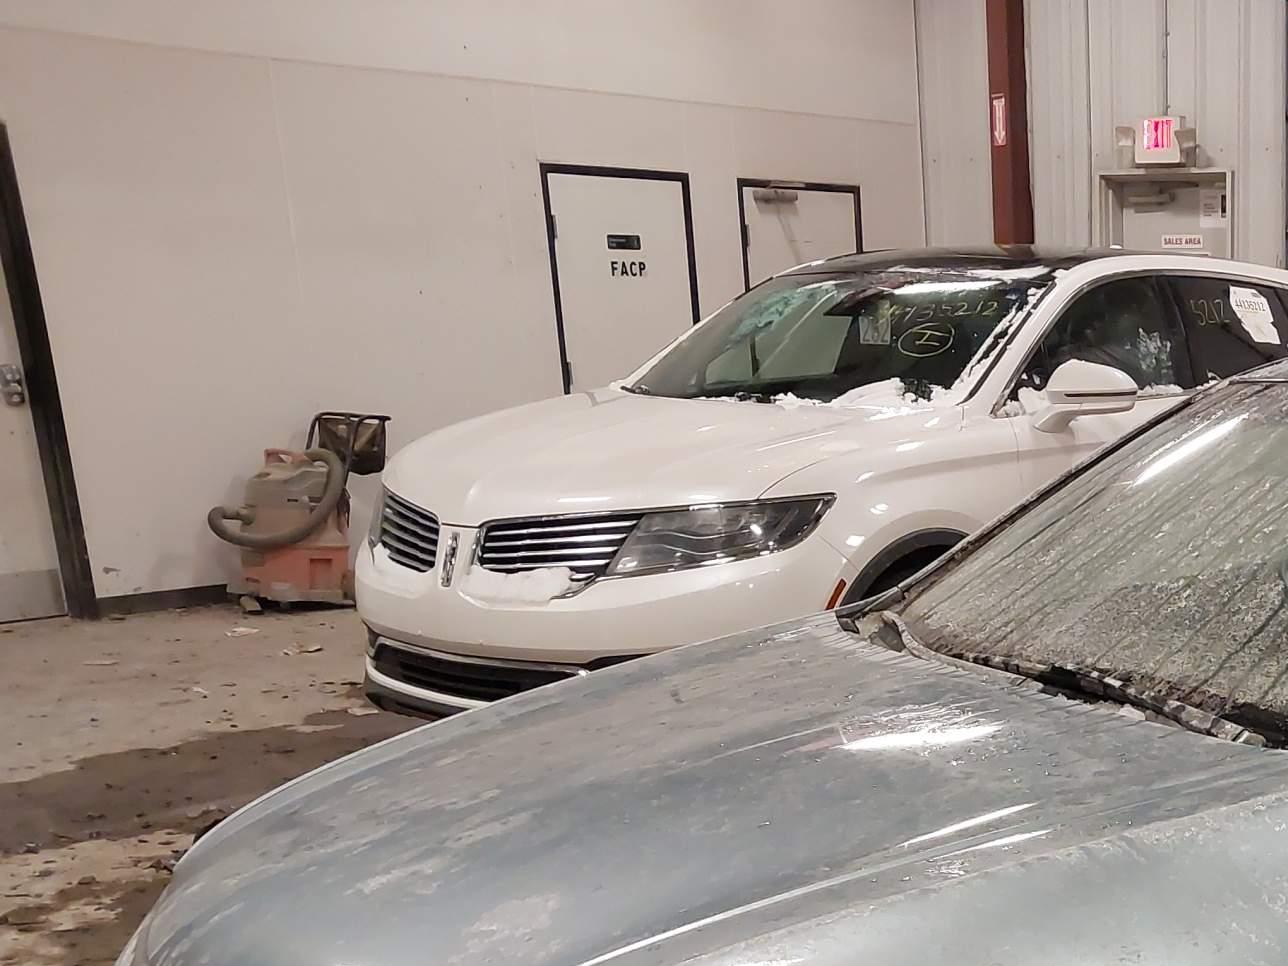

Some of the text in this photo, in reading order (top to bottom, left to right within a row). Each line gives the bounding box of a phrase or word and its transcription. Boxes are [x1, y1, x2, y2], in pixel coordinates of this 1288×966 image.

[1144, 119, 1174, 149] EXIT
[1163, 237, 1201, 246] SALES AREA
[610, 260, 646, 277] FACP
